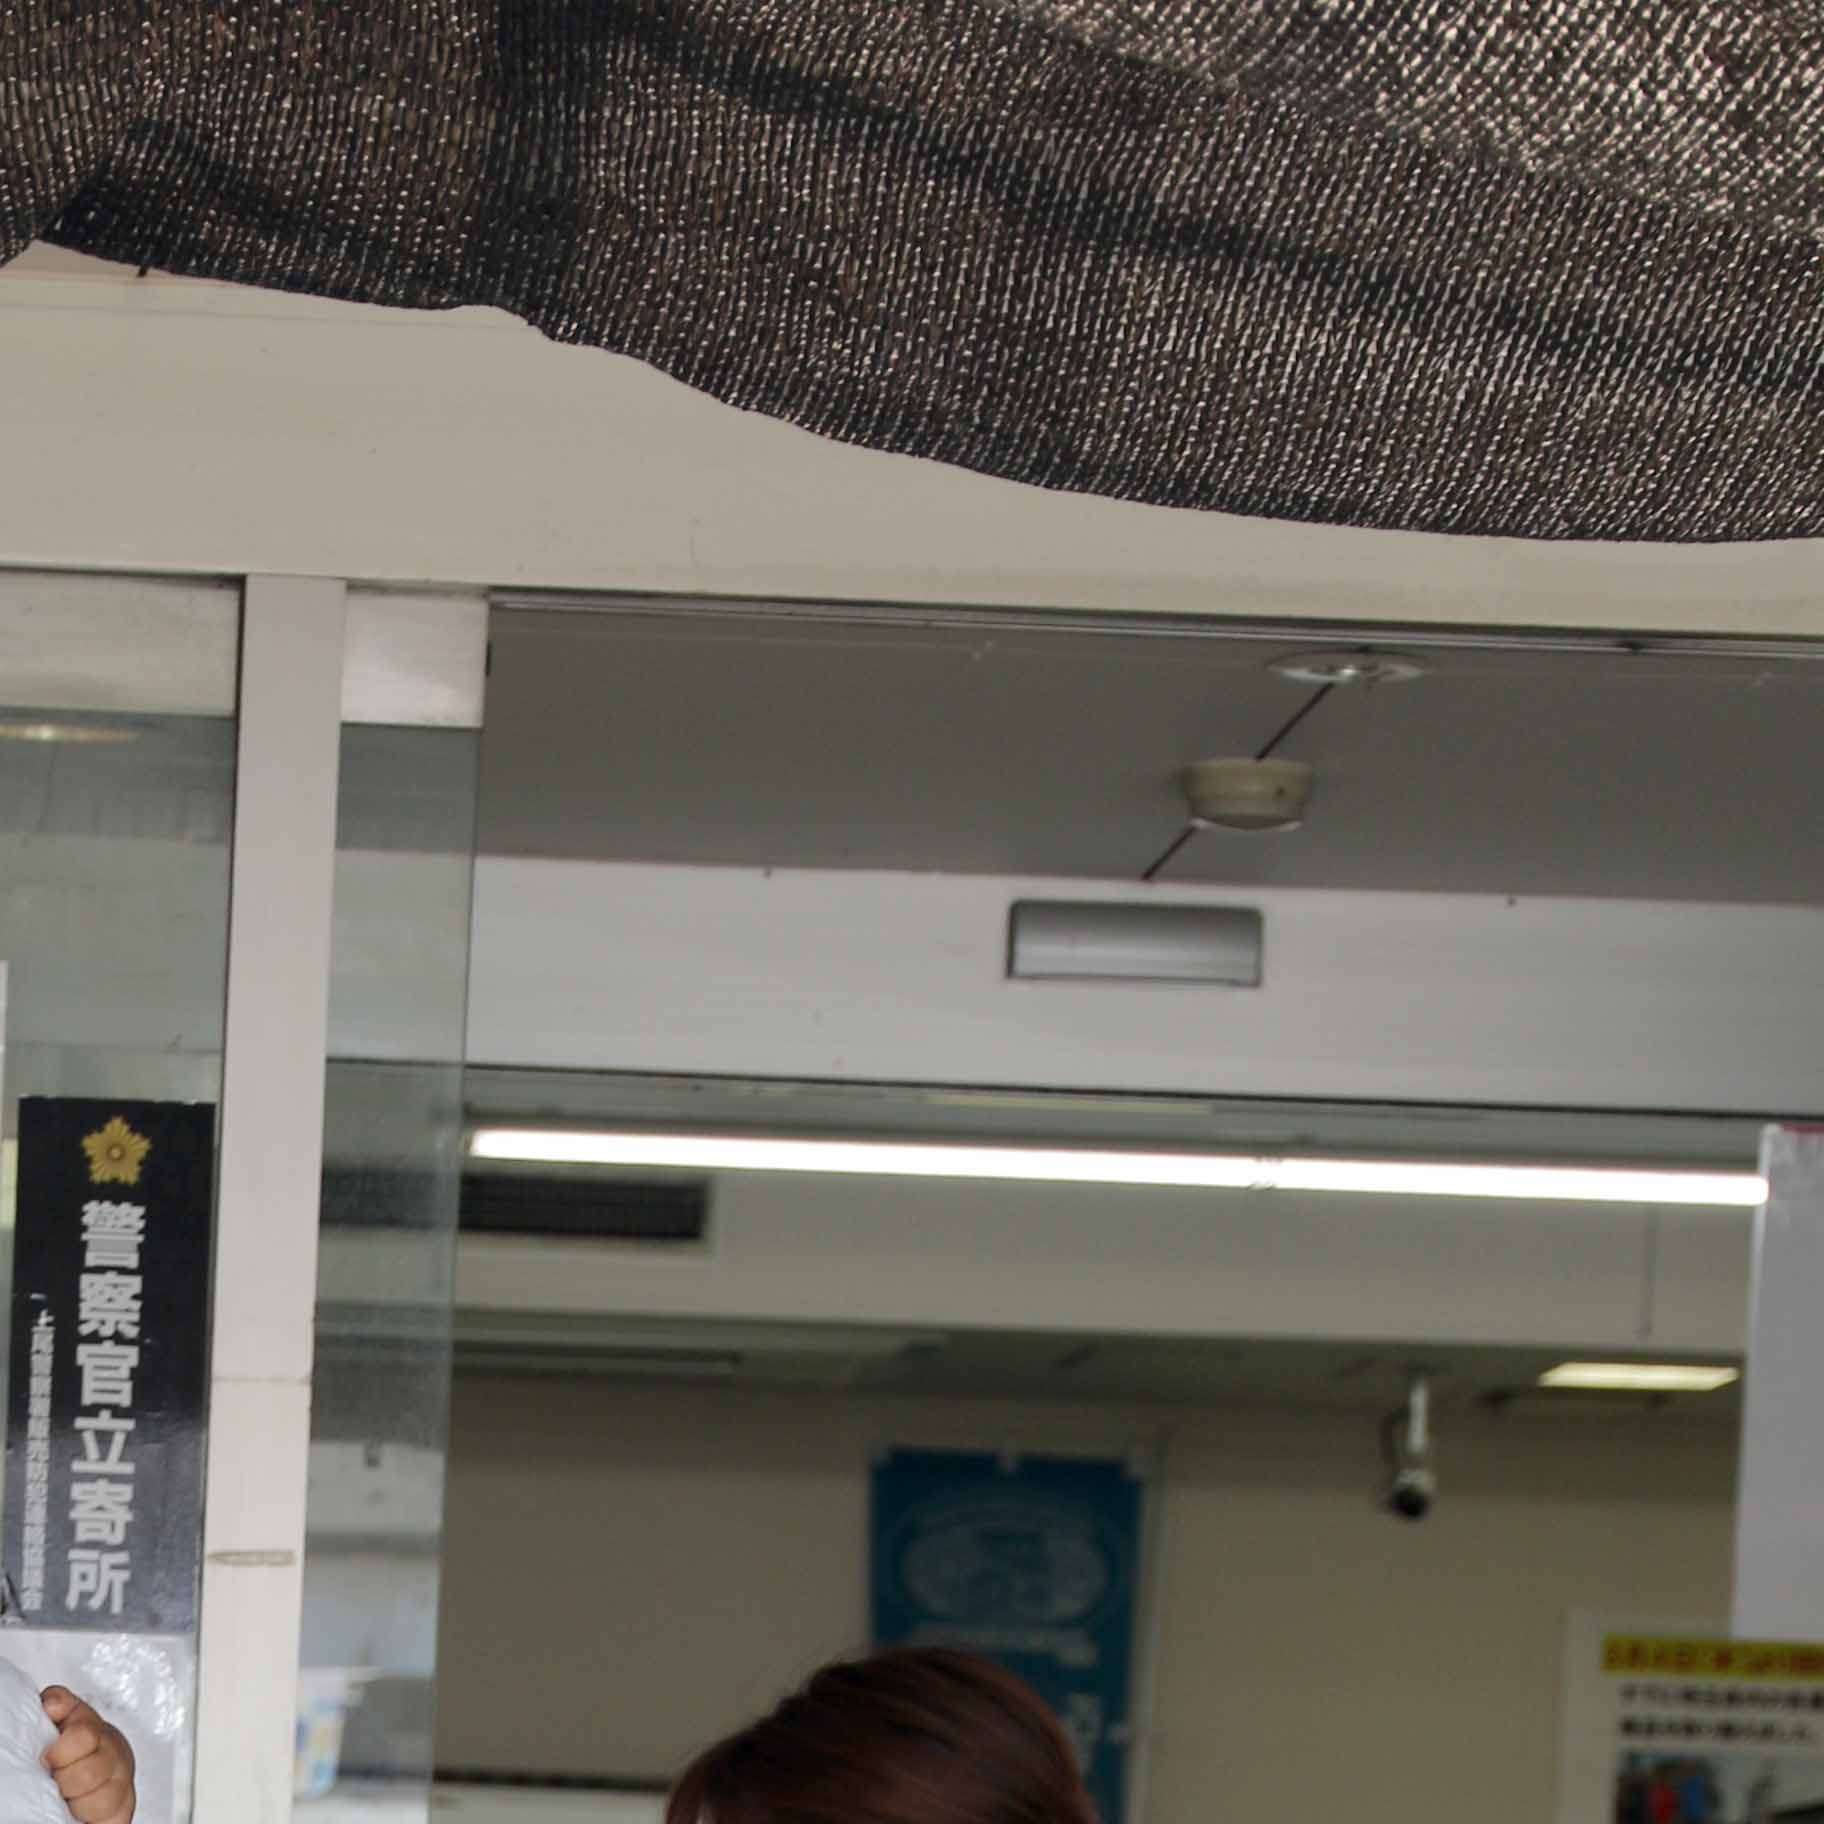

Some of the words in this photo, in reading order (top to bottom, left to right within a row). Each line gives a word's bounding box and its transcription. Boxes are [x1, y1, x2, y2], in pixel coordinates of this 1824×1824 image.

[65, 1200, 146, 1615] 警察官立寄所
